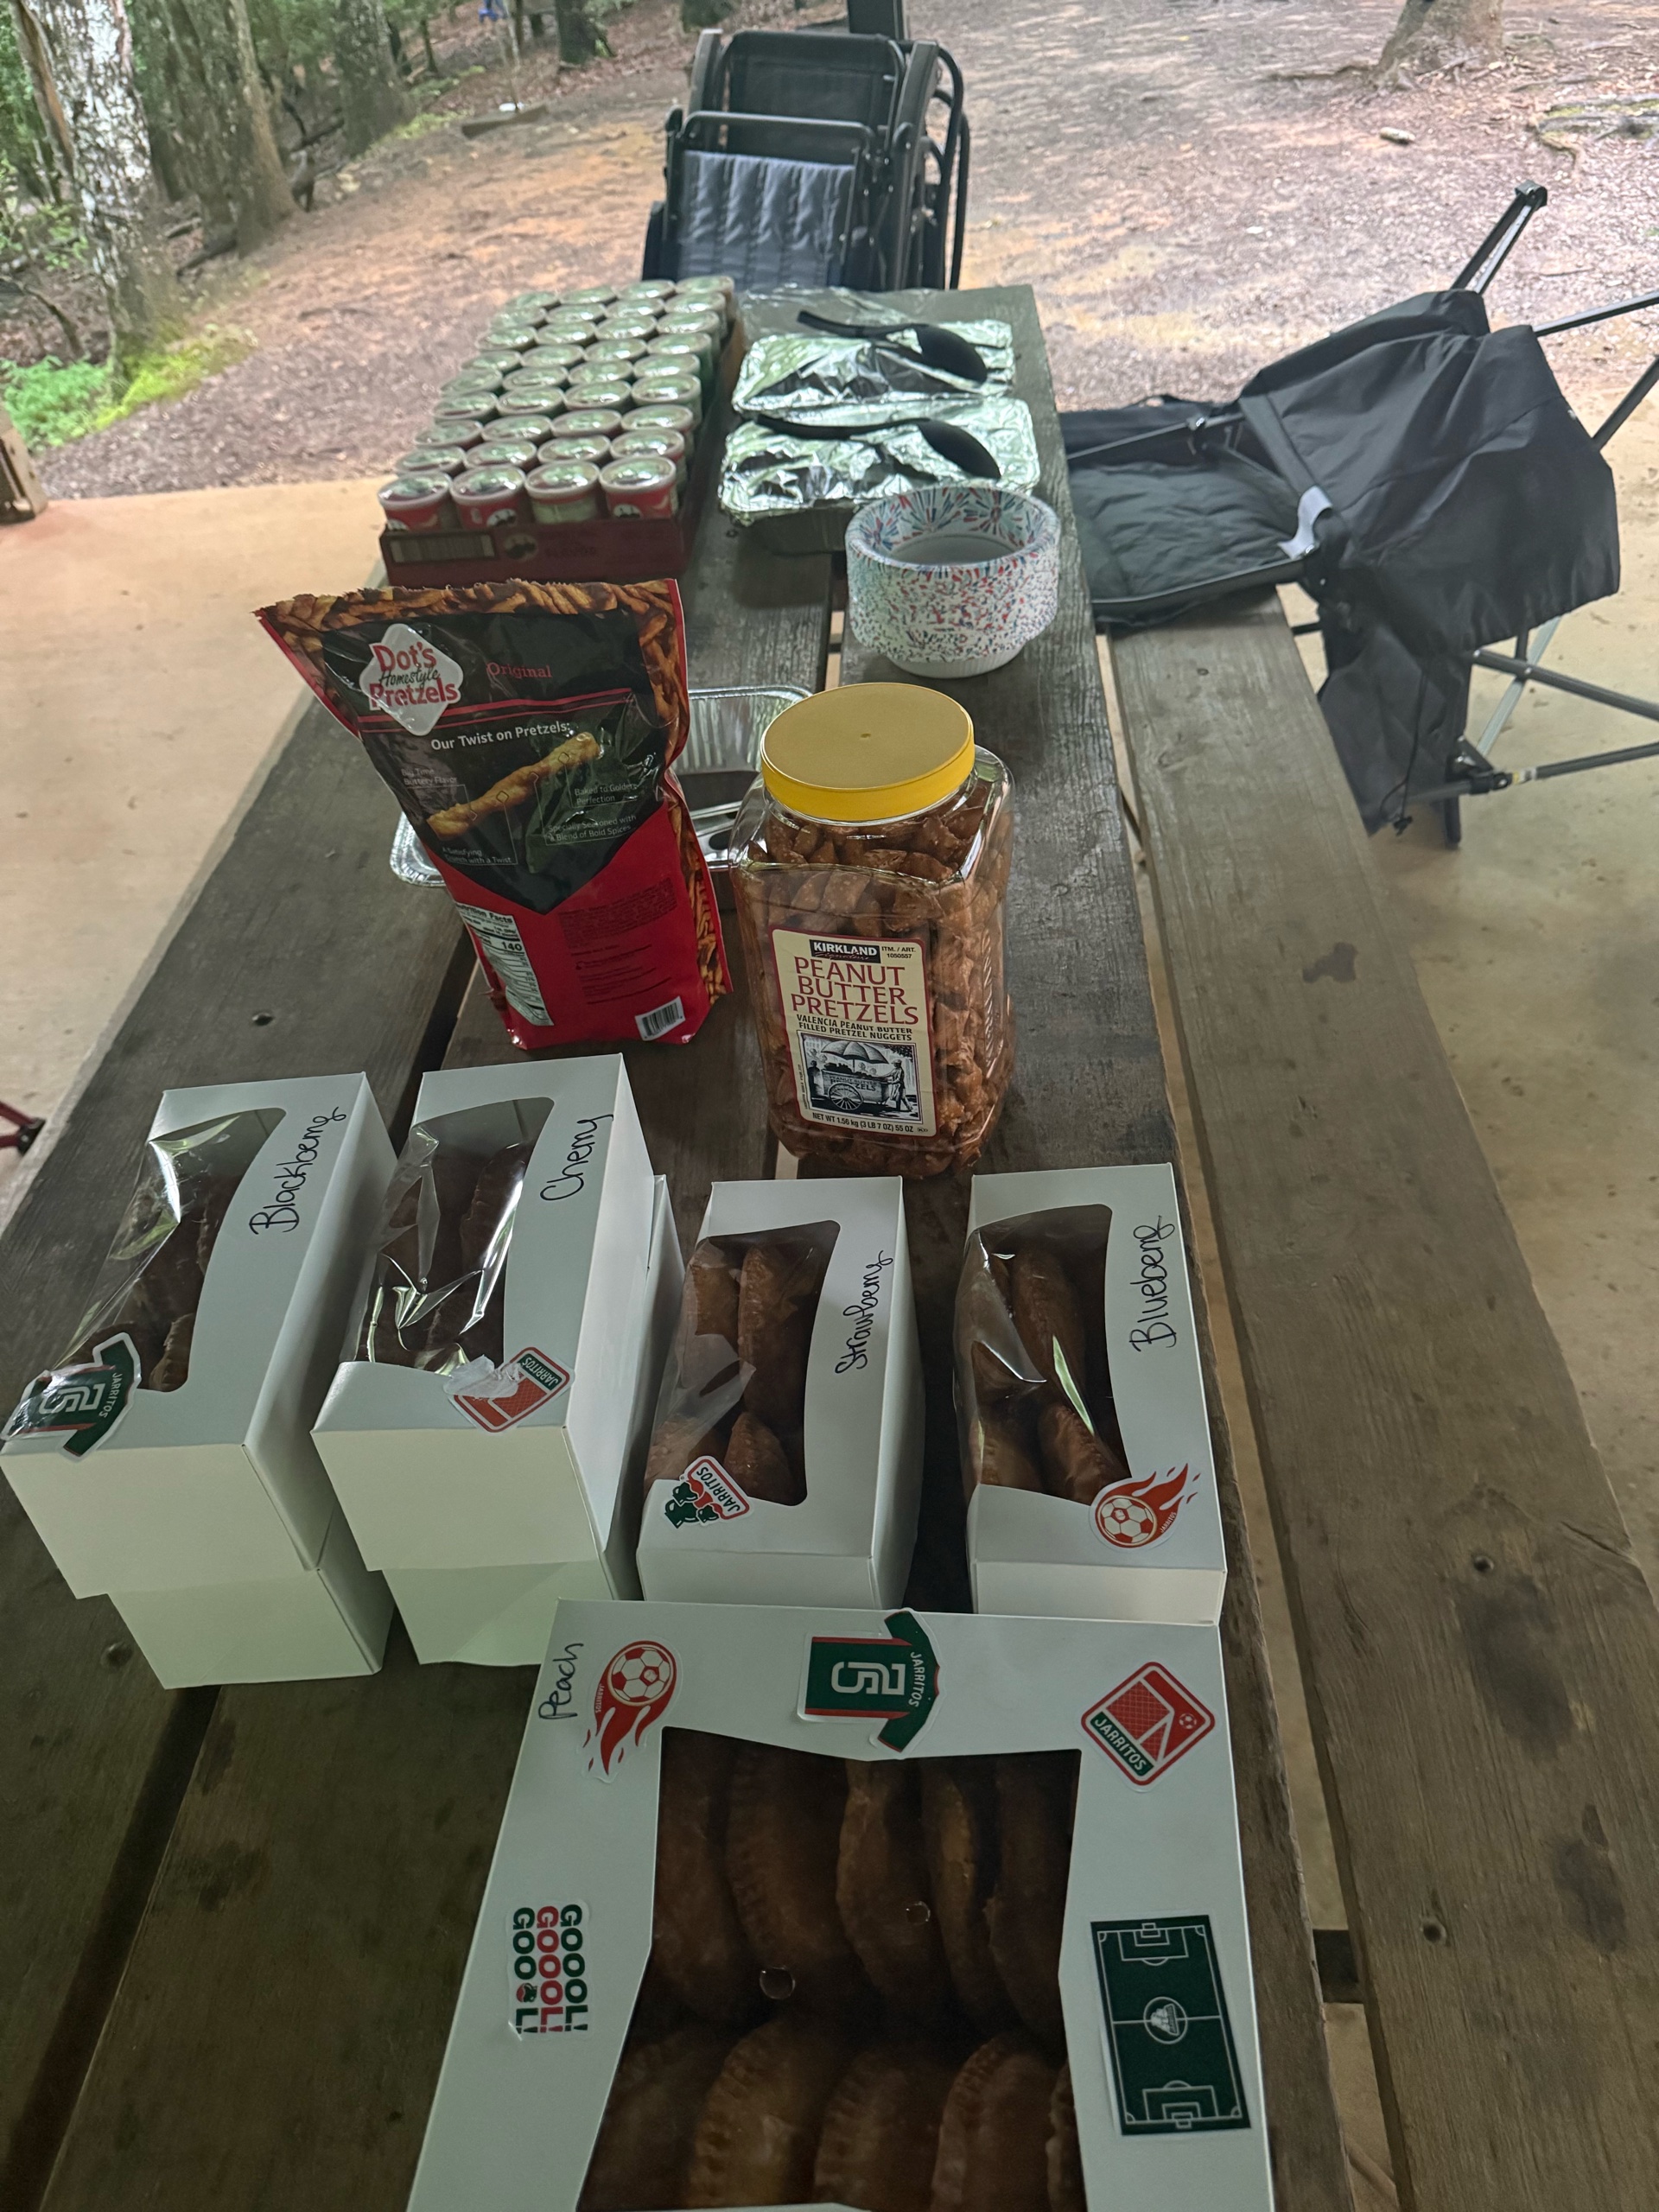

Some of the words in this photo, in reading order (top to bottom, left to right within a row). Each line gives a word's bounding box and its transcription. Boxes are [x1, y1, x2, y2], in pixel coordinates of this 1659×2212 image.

[372, 641, 437, 671] Dot's
[486, 662, 553, 679] Original
[378, 667, 440, 688] Homestyle
[369, 677, 459, 709] Pretzels
[431, 738, 454, 751] Our
[458, 733, 493, 748] Twist
[496, 730, 512, 741] on
[515, 721, 570, 739] Pretzels:
[574, 785, 598, 796] Baked
[576, 795, 615, 805] Perfection
[556, 831, 577, 842] Blend
[579, 830, 588, 839] of
[588, 829, 606, 838] Bold
[607, 825, 632, 836] Spices
[619, 815, 637, 824] with
[489, 912, 513, 924] Facts
[501, 941, 523, 952] 140
[813, 942, 877, 956] KIRKLAND
[794, 956, 905, 986] PEANUT
[798, 975, 907, 1006] BUTTER
[791, 994, 918, 1025] PRETZELS
[797, 1014, 837, 1027] VALENCIA
[840, 1020, 874, 1032] PEANUT
[798, 1022, 827, 1033] FILLED
[830, 1027, 868, 1038] PRETZEL
[870, 1032, 912, 1041] NUGGETS
[825, 1114, 836, 1122] WT
[851, 1119, 859, 1128] kg
[860, 1120, 867, 1129] (3
[868, 1121, 876, 1129] LB
[882, 1123, 894, 1132] OZ)
[249, 1106, 346, 1235] Blackberry
[539, 1114, 613, 1201] Cherry
[1128, 1215, 1177, 1352] Blueberry
[835, 1250, 893, 1374] Strawberry
[521, 1357, 559, 1387] JARRITOS
[99, 1372, 123, 1419] JARRITOS
[696, 1466, 741, 1512] JARRITOS
[1160, 1511, 1177, 1534] JARRITOS
[537, 1643, 584, 1719] Peach
[908, 1651, 925, 1707] JARRITOS
[1094, 1719, 1147, 1770] JARRITOS
[537, 1905, 563, 2033] GOOOL!
[560, 1904, 588, 2031] GOOOL!
